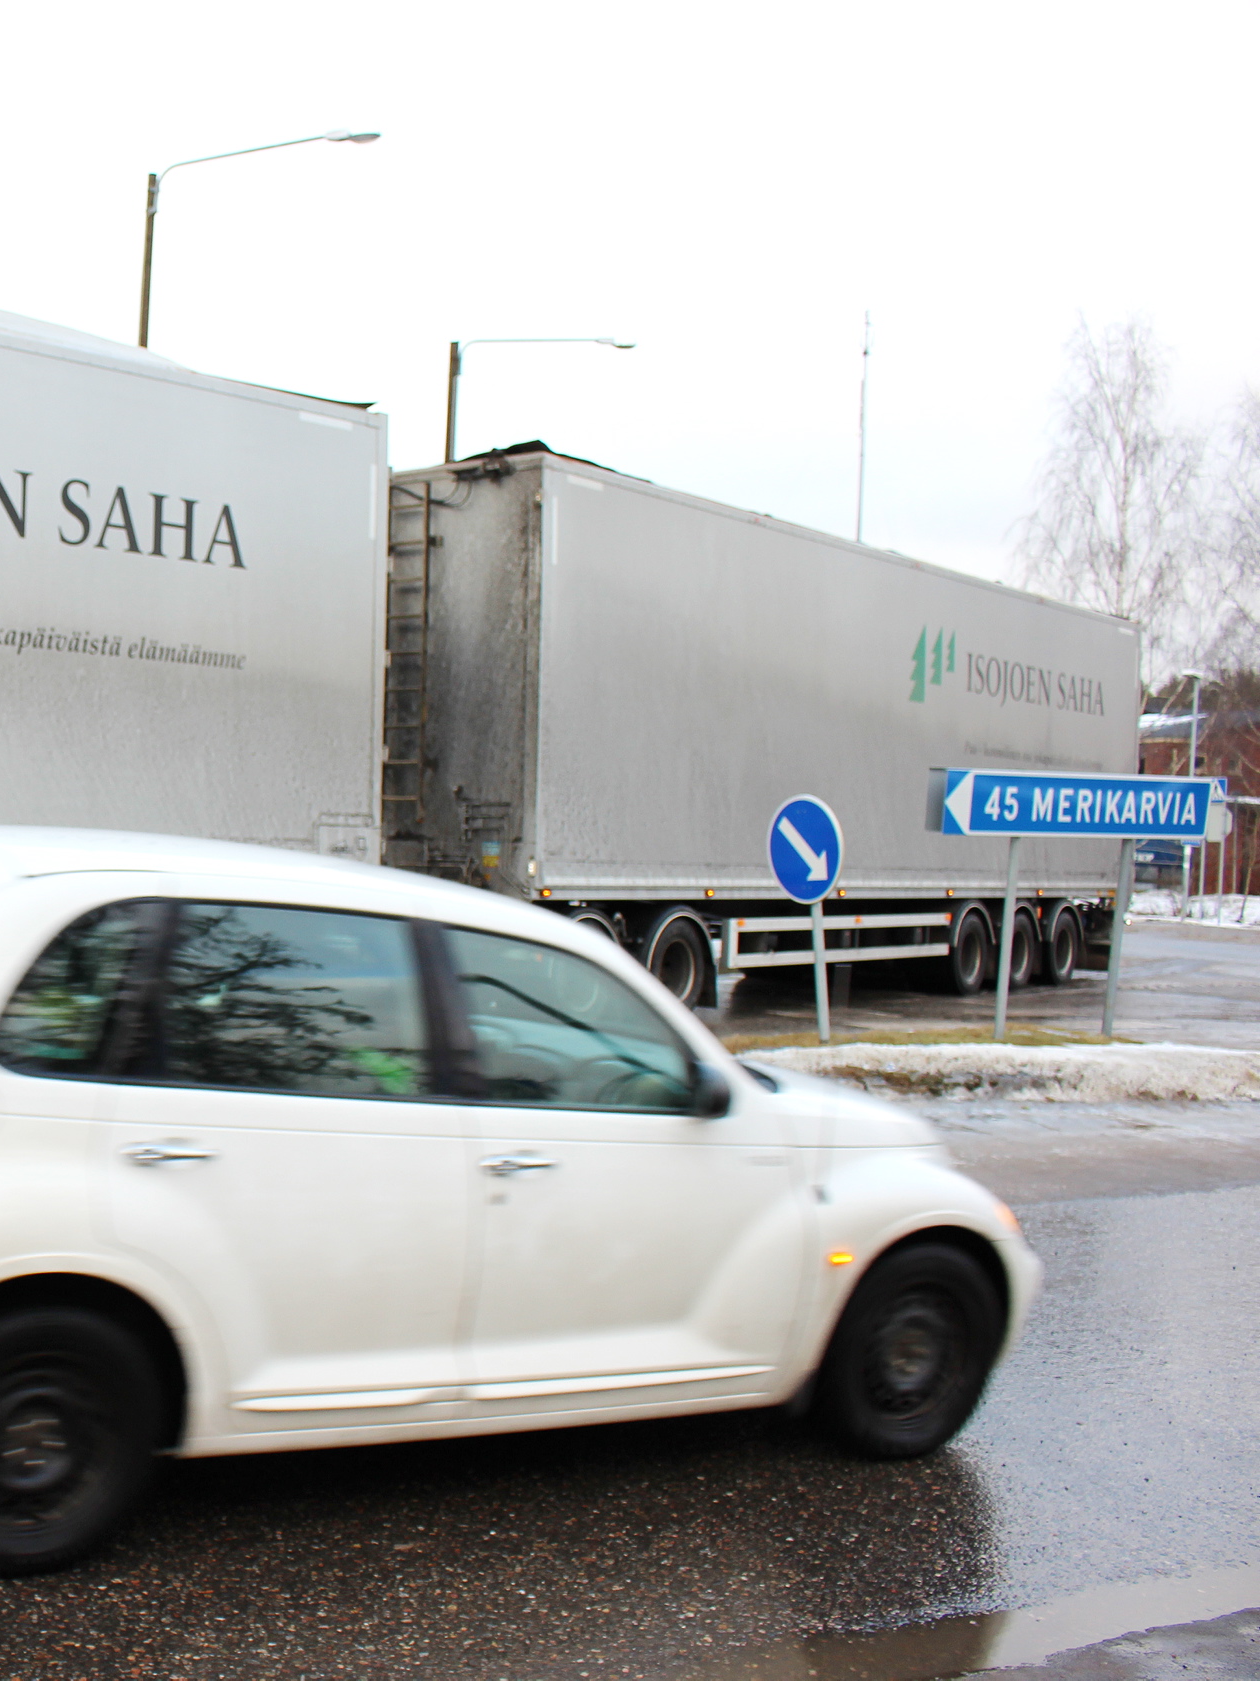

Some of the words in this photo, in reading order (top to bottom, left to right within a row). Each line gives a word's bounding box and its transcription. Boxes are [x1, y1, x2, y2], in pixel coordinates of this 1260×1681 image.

[57, 479, 247, 569] SAHA
[127, 636, 247, 671] elämäämme
[966, 653, 1052, 707] ISOJOEN
[1057, 671, 1105, 716] SAHA
[984, 786, 1019, 821] 45
[1031, 787, 1197, 826] MERIKARVIA
